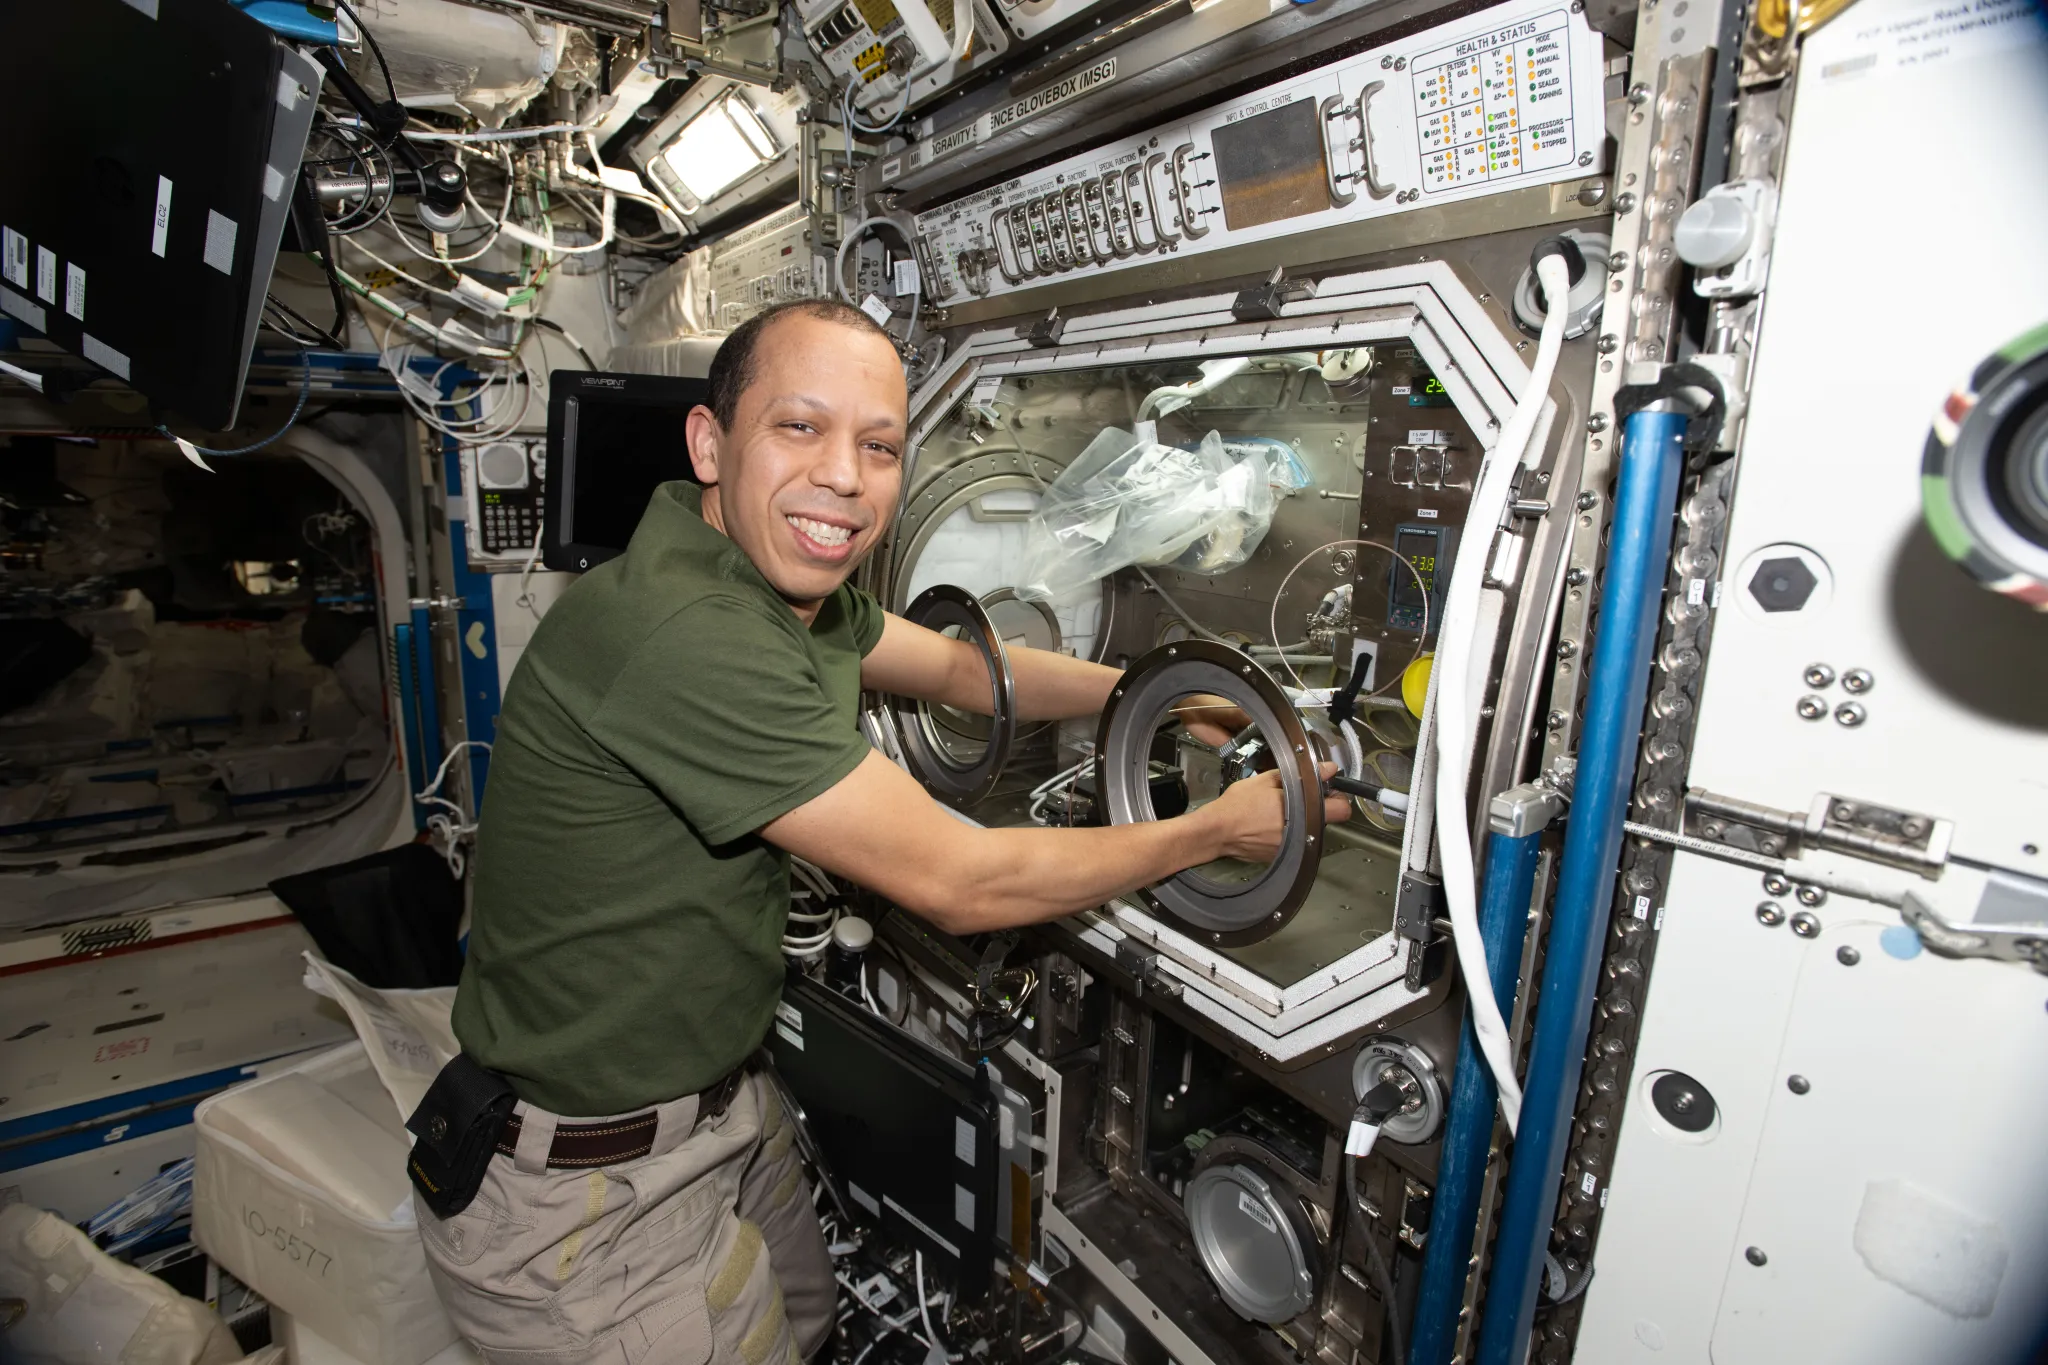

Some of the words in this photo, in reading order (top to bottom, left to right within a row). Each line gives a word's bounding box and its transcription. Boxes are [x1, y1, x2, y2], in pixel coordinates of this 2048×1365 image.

[1456, 37, 1489, 56] HEALTH
[1491, 35, 1498, 46] &
[1500, 22, 1536, 42] STATUS
[1535, 34, 1550, 44] MODE
[1536, 43, 1559, 54] NORMAL
[1447, 60, 1467, 71] FILTERS
[1536, 54, 1560, 66] MANUAL
[1457, 69, 1468, 77] GAS
[1537, 68, 1552, 77] OPEN
[1016, 78, 1076, 116] GLOVEBOX
[1080, 61, 1116, 90] (MSG)
[1426, 79, 1436, 87] GAS
[1492, 81, 1504, 90] HUM
[1537, 77, 1560, 89] SEALED
[1538, 89, 1562, 100] DONNING
[1226, 112, 1238, 122] INFO
[1246, 102, 1269, 116] CONTROL
[1271, 93, 1293, 107] CENTRE
[1528, 119, 1564, 131] PROCESSORS
[1541, 127, 1565, 138] RUNNING
[1541, 137, 1567, 149] STOPPED
[1098, 160, 1114, 171] SPECIAL
[1115, 152, 1137, 166] FUNCTIONS
[1067, 169, 1087, 182] FUNCTIONS
[919, 207, 943, 222] COMMAND
[942, 204, 954, 215] AND
[953, 192, 985, 211] MONITORING
[985, 184, 1005, 200] PANEL
[1005, 179, 1022, 191] (CMP)
[157, 204, 167, 228] ELC2
[757, 226, 767, 236] LAB
[766, 216, 787, 230] FREEZER
[580, 377, 627, 387] VIEWPOINT
